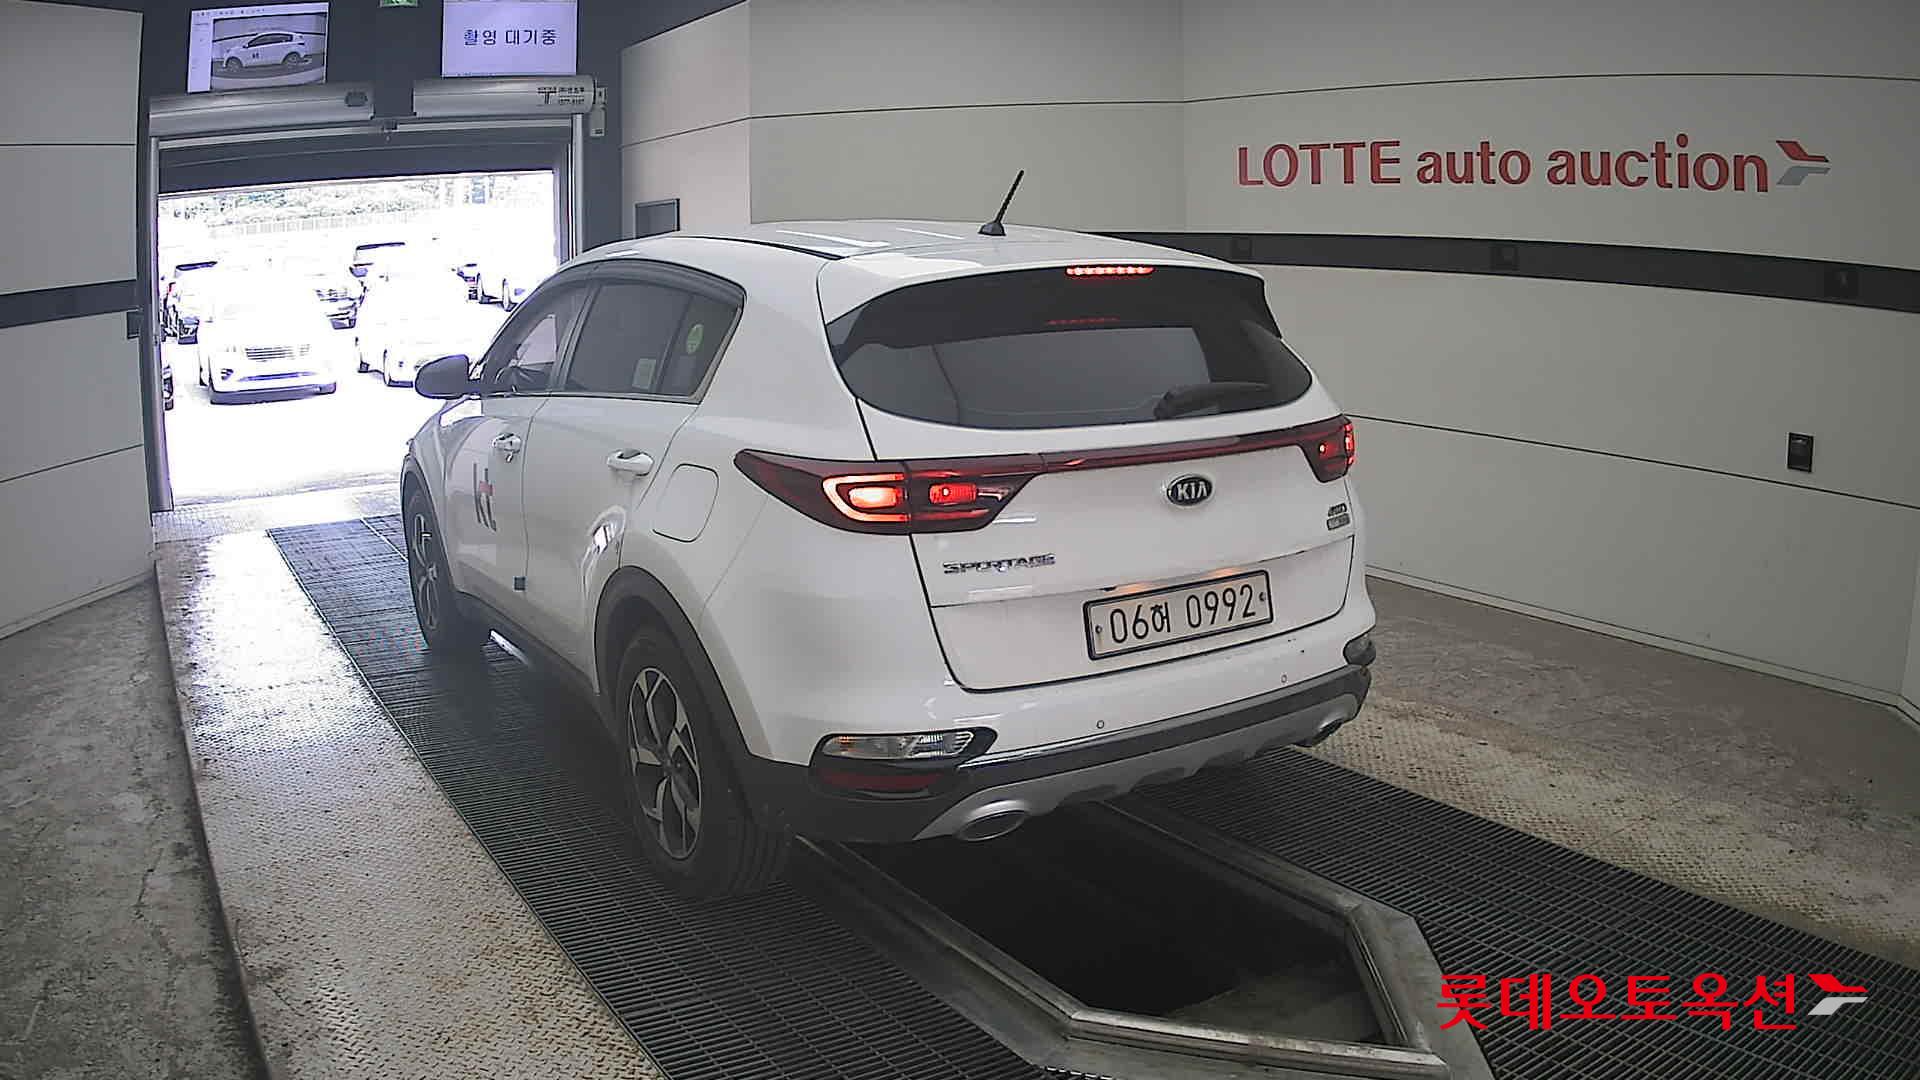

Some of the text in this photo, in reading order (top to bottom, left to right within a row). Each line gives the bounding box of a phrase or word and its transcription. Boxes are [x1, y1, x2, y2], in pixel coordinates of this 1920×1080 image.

[505, 28, 557, 46] 대기중
[1238, 133, 1769, 193] LOTTE auto auction
[1176, 481, 1208, 501] KIA
[943, 553, 1056, 574] SPORTAGE
[1110, 583, 1257, 643] 06허 0992
